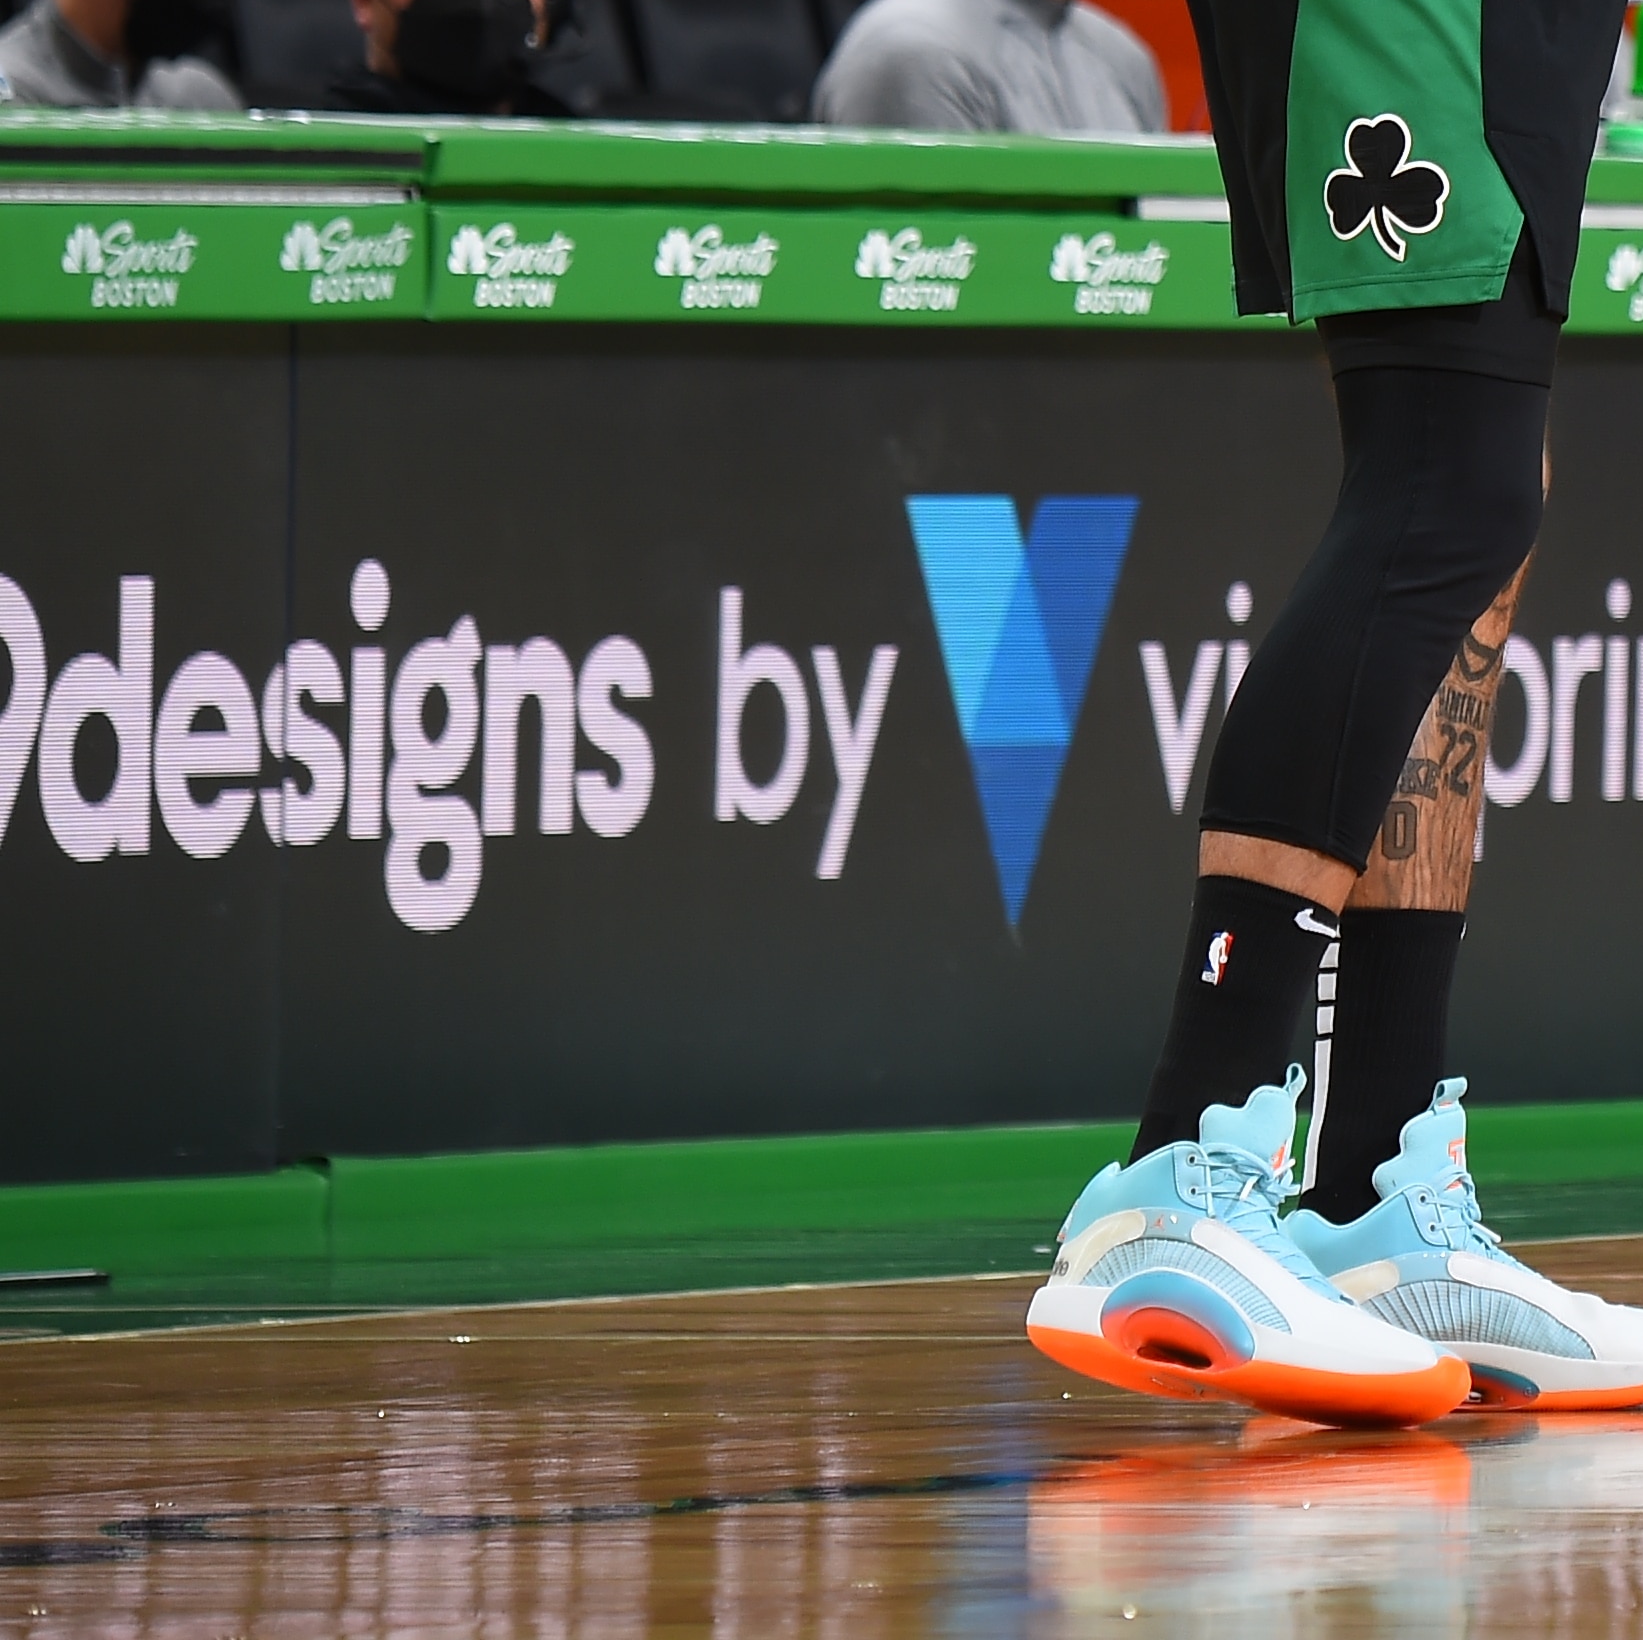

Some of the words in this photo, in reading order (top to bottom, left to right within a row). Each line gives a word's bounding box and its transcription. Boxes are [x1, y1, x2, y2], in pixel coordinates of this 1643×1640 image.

[91, 277, 180, 309] BOSTON
[309, 272, 397, 304] BOSTON
[473, 279, 558, 308] BOSTON
[680, 279, 763, 309] BOSTON
[879, 281, 960, 311] BOSTON
[1074, 286, 1154, 315] BOSTON
[714, 584, 900, 881] by
